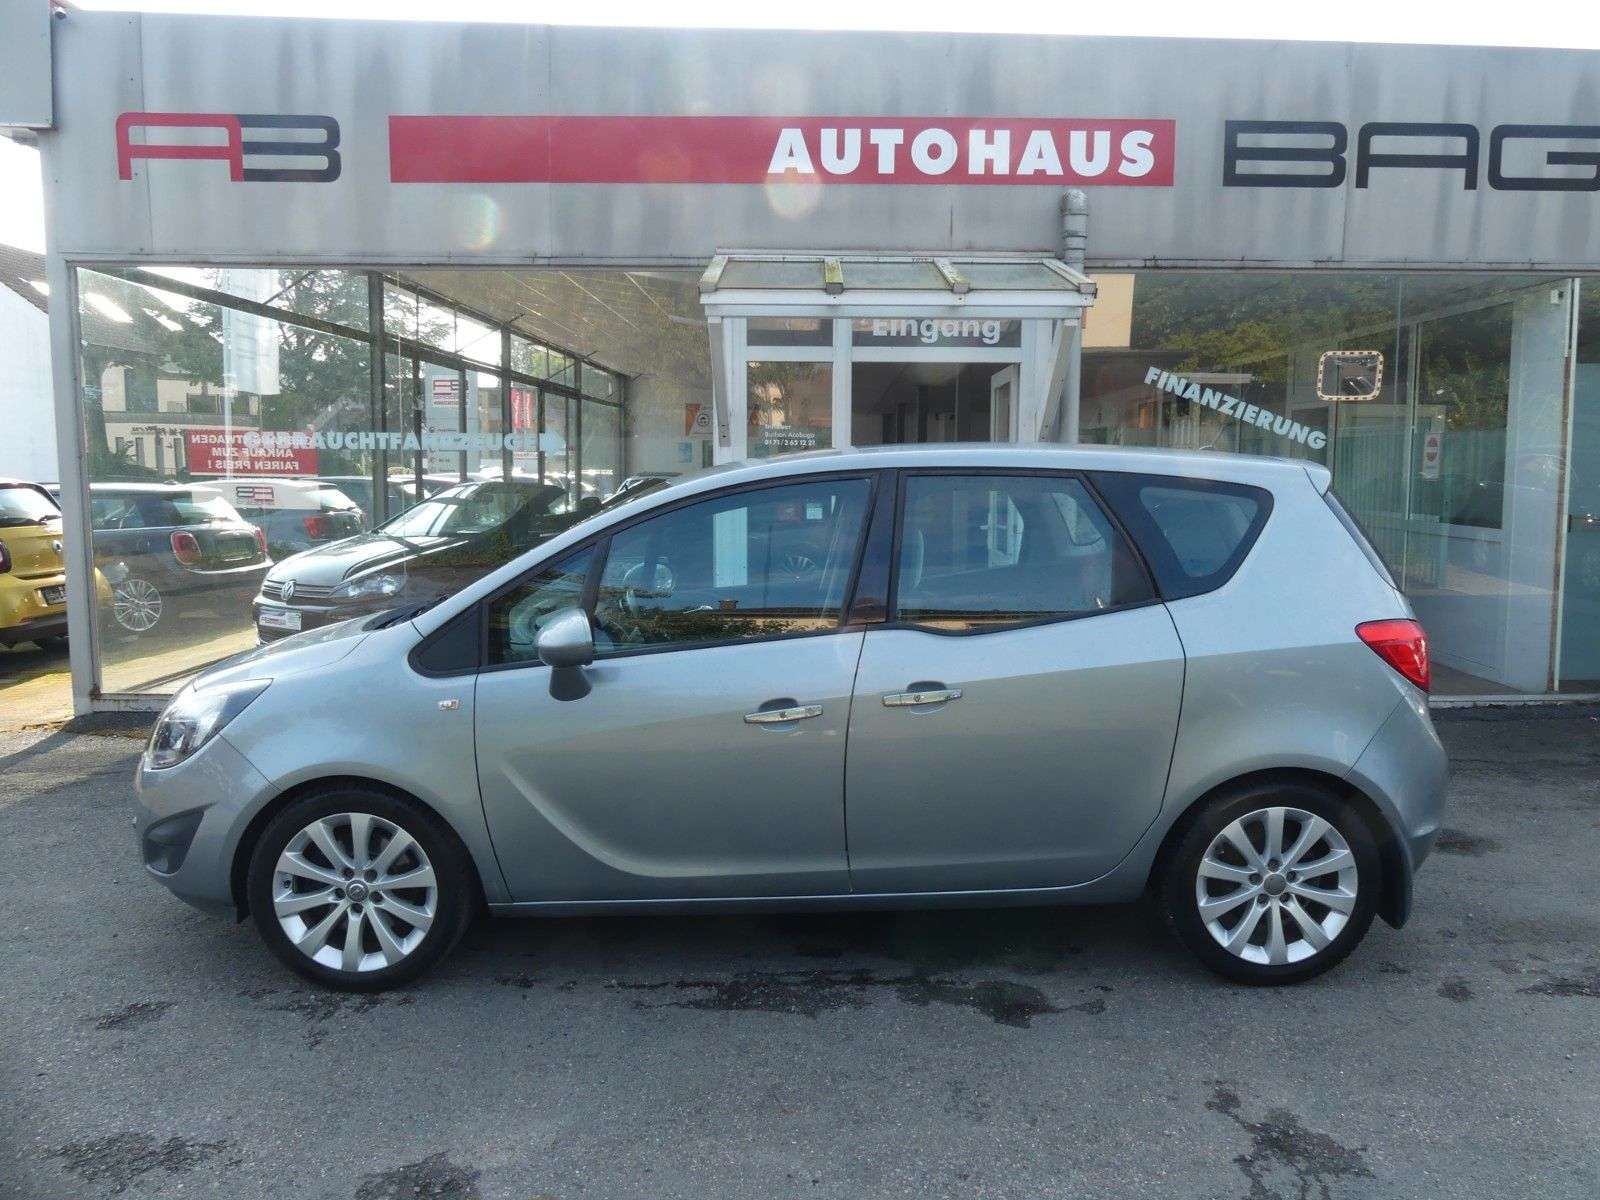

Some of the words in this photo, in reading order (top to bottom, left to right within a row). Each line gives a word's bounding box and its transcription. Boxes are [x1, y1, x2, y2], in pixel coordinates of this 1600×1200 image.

[116, 112, 341, 183] AB
[767, 128, 1155, 177] AUTOHAUS
[872, 319, 1001, 345] Eingang
[1144, 366, 1328, 450] FINANZIERUNG
